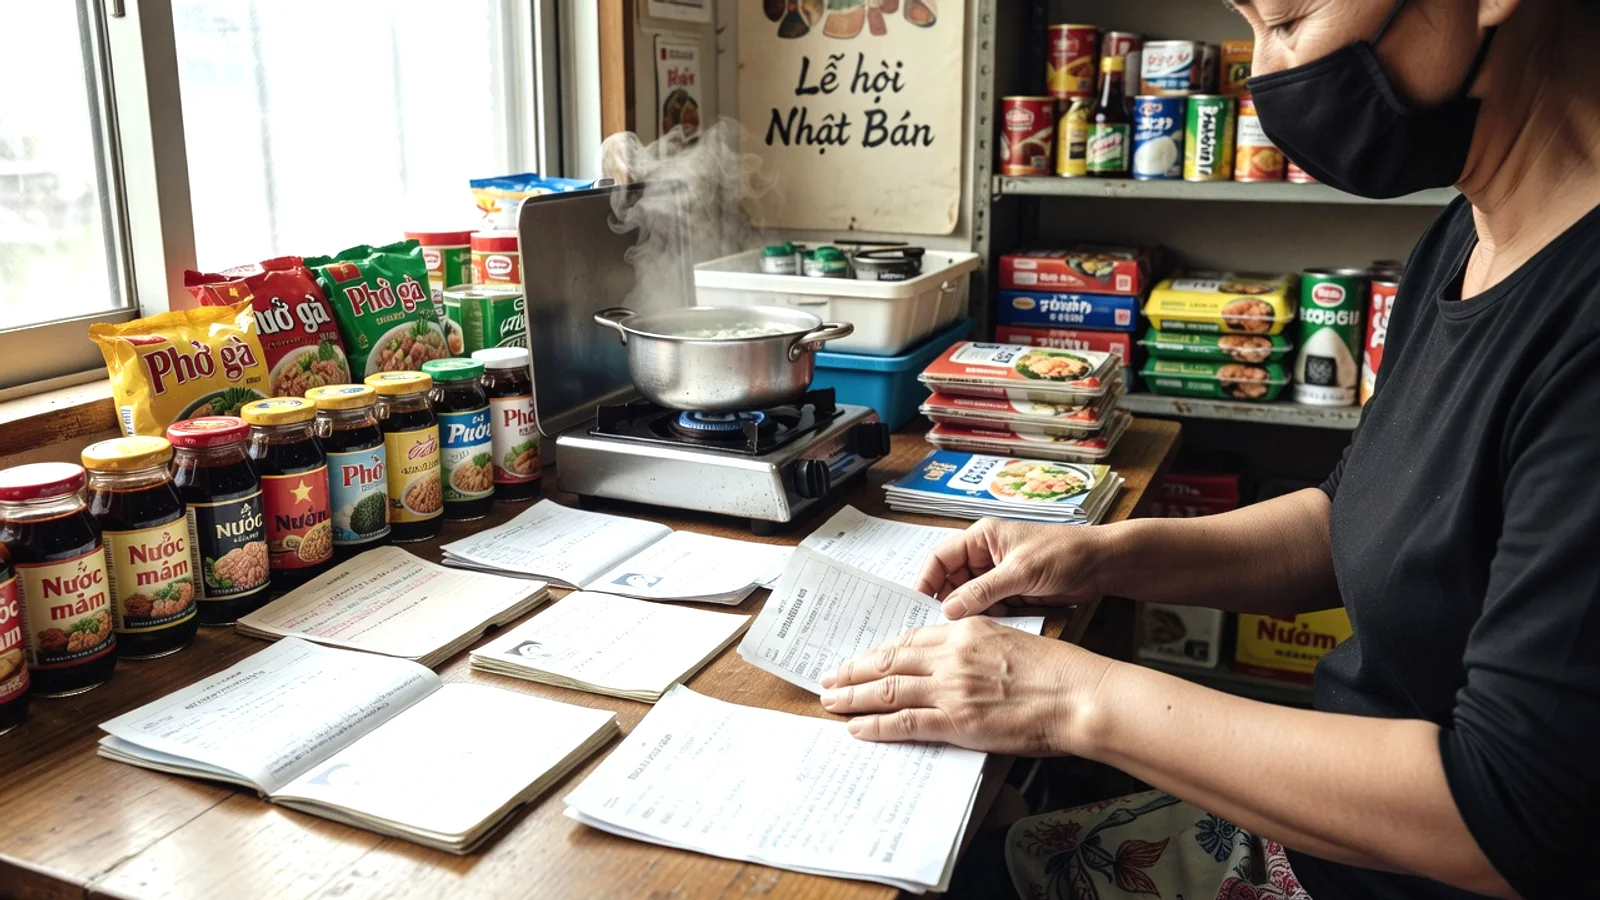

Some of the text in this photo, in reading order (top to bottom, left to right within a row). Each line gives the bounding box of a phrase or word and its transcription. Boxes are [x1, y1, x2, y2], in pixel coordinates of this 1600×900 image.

[795, 52, 845, 96] Lễ
[765, 106, 852, 155] Nhật
[296, 293, 331, 334] gà
[220, 334, 258, 382] gà
